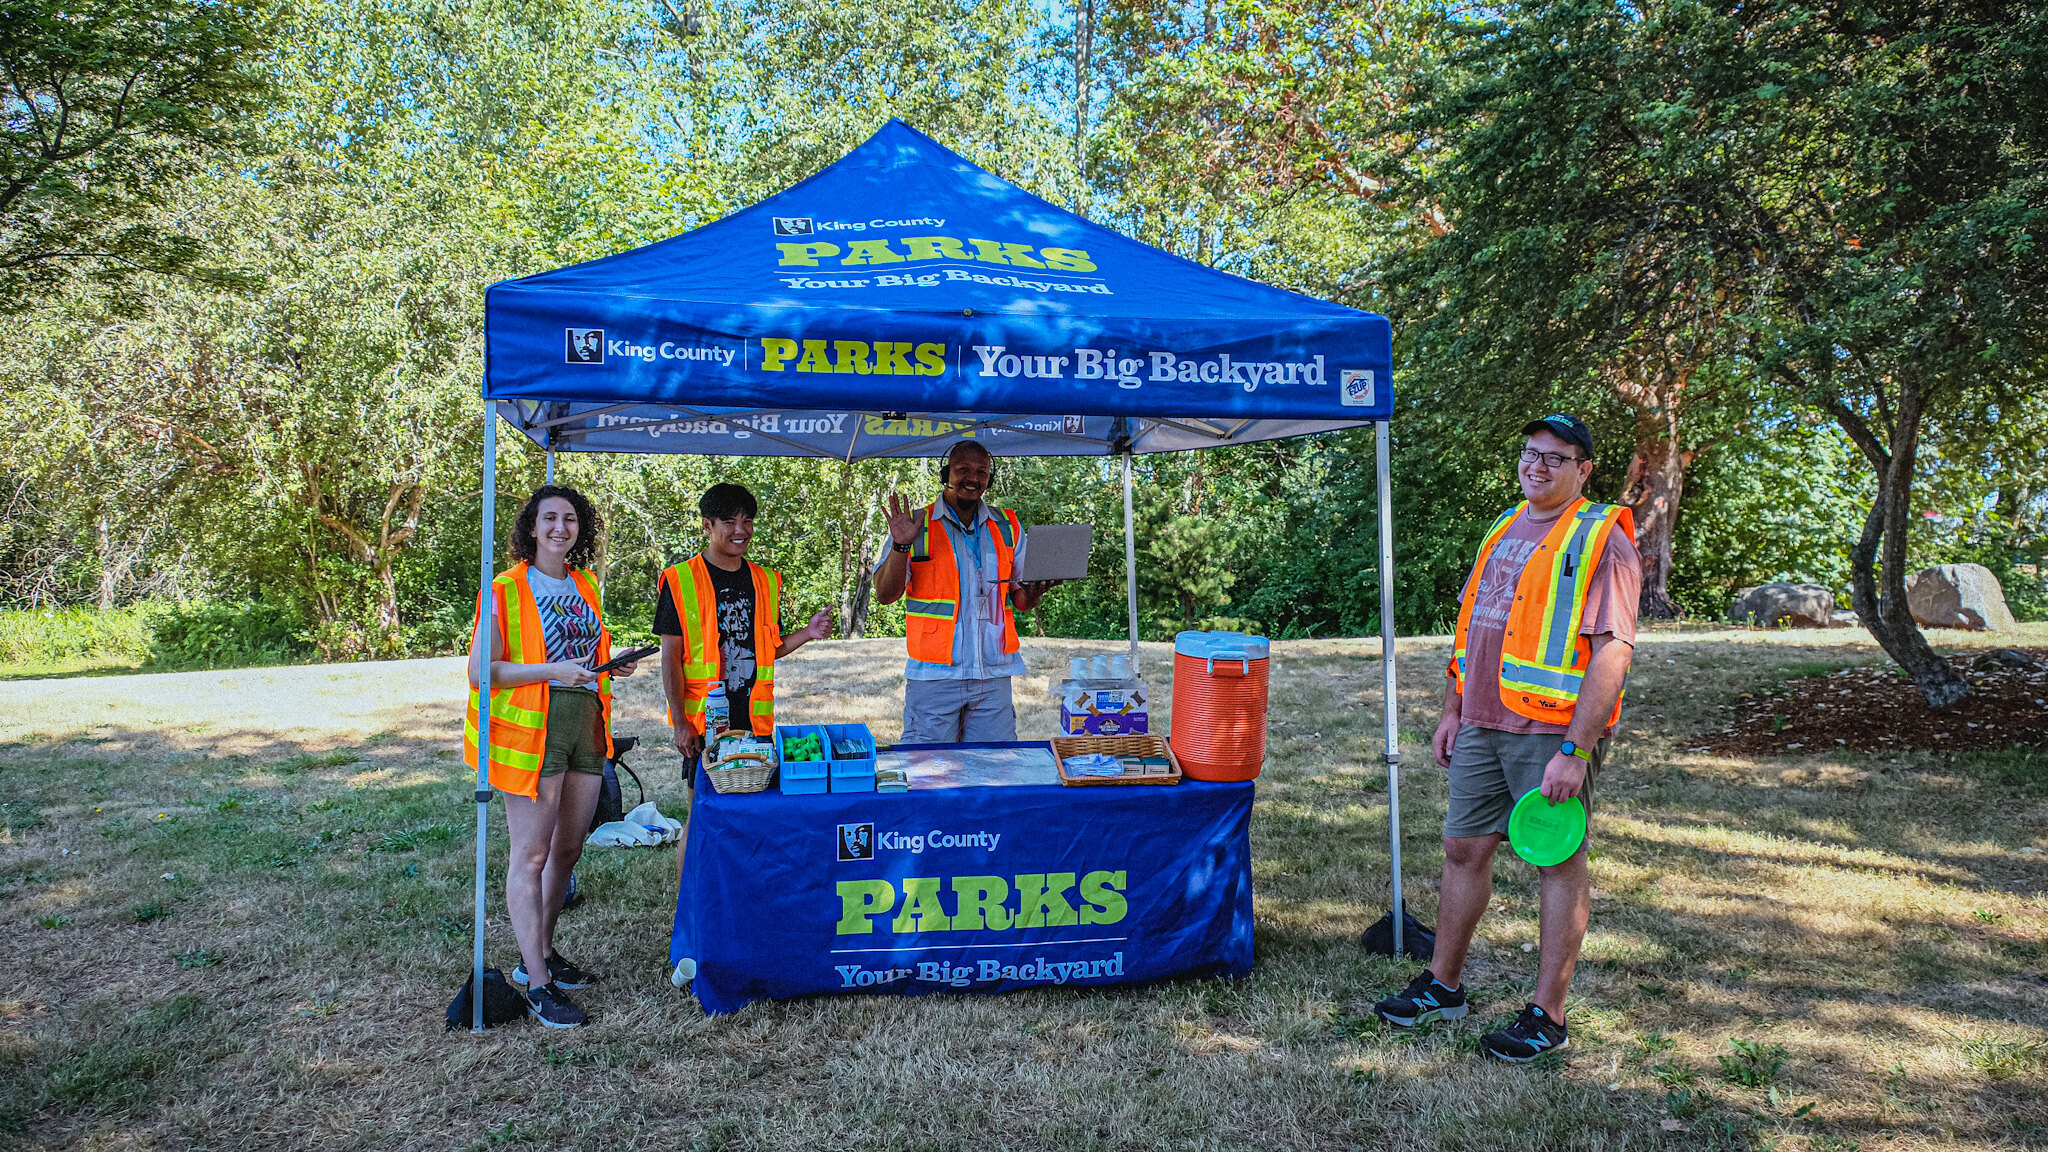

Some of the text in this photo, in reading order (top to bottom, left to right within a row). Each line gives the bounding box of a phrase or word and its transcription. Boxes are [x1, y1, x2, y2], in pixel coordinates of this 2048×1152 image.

[816, 217, 946, 232] King County
[776, 236, 1098, 273] PARKS
[780, 269, 1113, 295] Your Big Backyard
[608, 337, 1327, 392] King County PARKS Your Big Backyard
[554, 602, 585, 617] NEW
[877, 830, 1000, 854] King County
[836, 870, 1128, 935] PARKS
[834, 951, 1124, 988] Your Big Backyard
